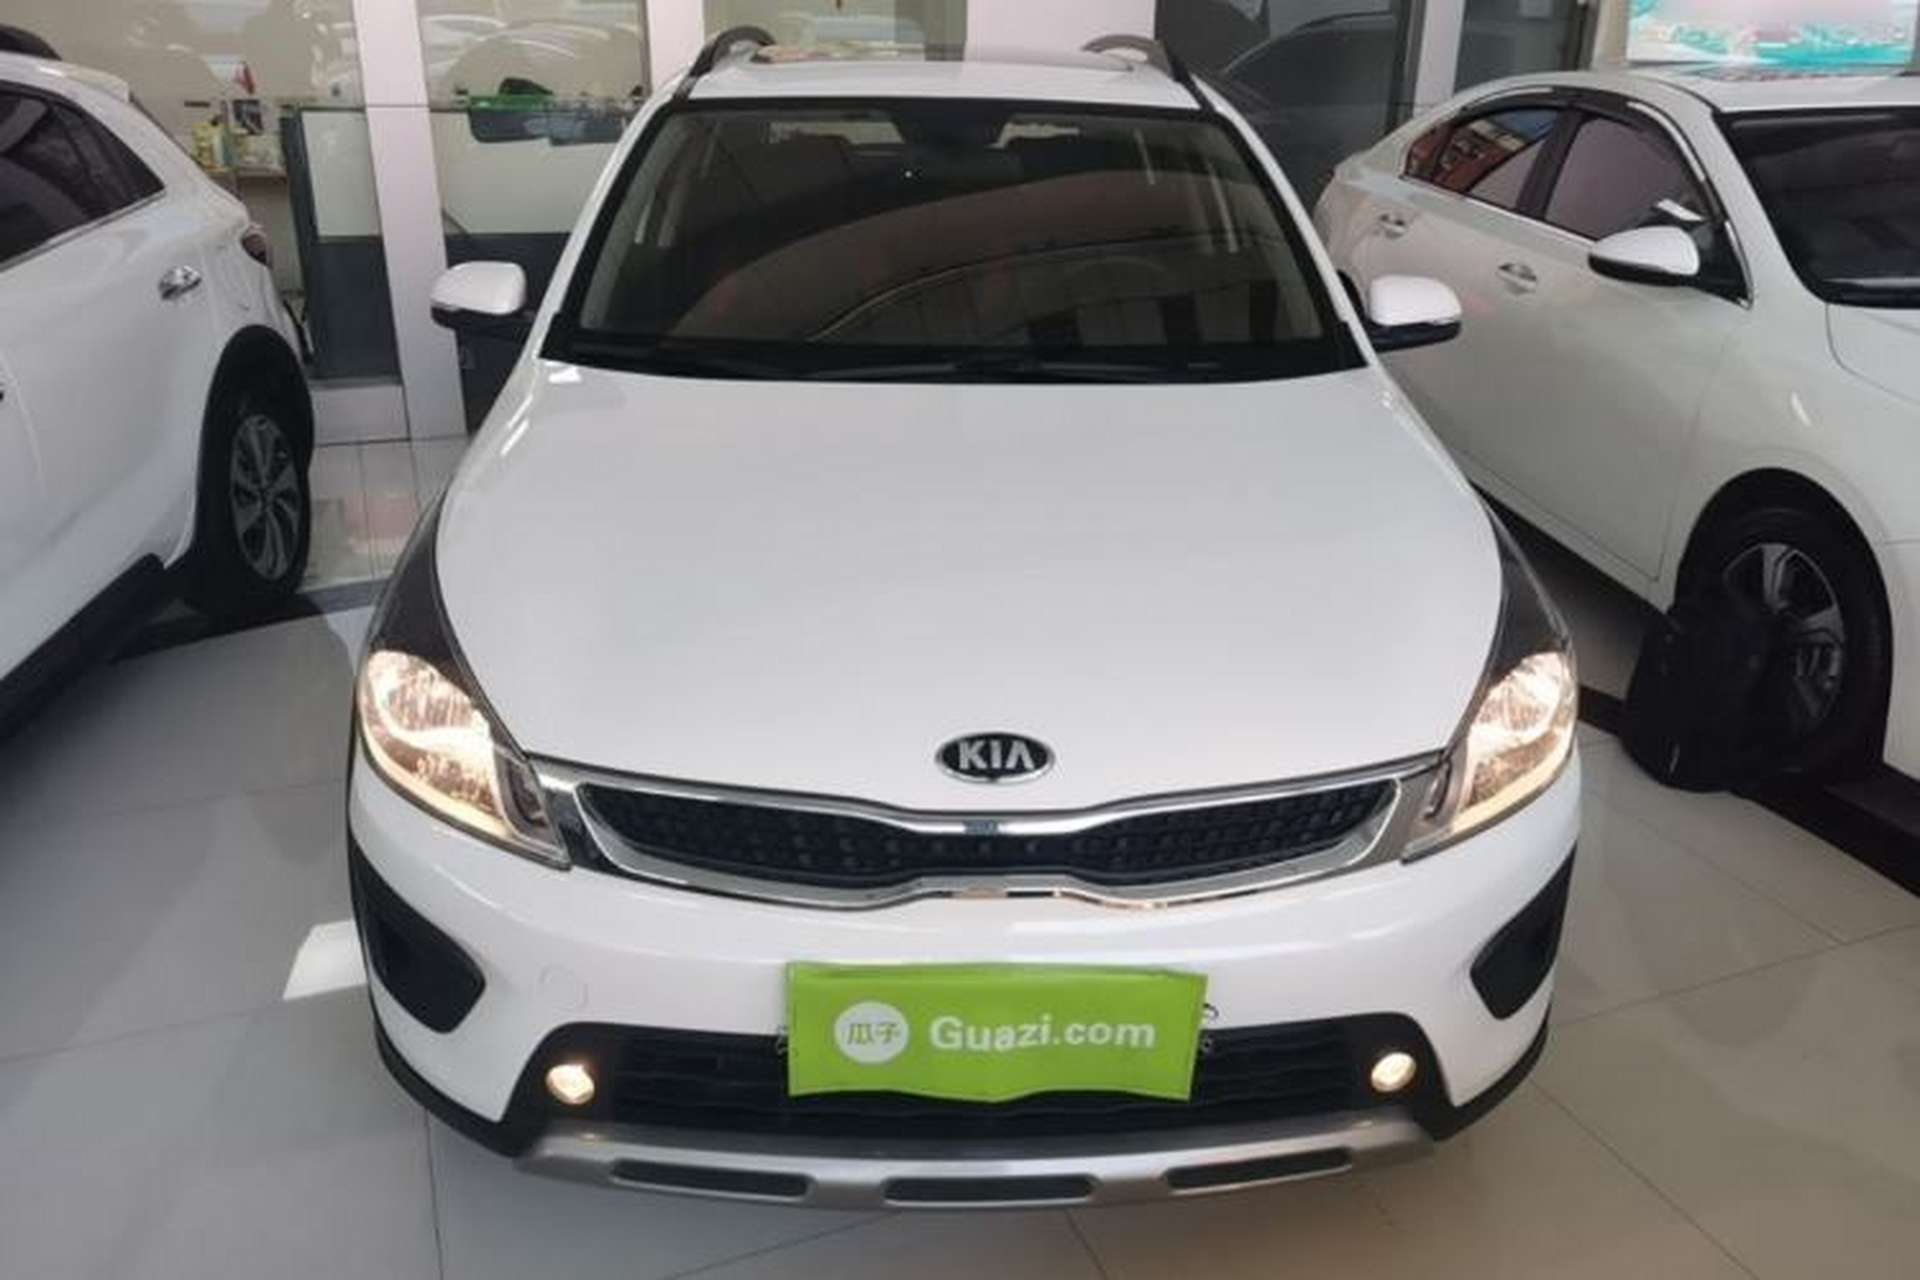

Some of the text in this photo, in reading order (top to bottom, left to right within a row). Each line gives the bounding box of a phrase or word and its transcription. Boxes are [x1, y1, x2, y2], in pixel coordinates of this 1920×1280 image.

[957, 739, 1035, 770] KIA
[846, 1021, 900, 1046] 瓜子
[929, 1014, 1156, 1052] Guazi.com
